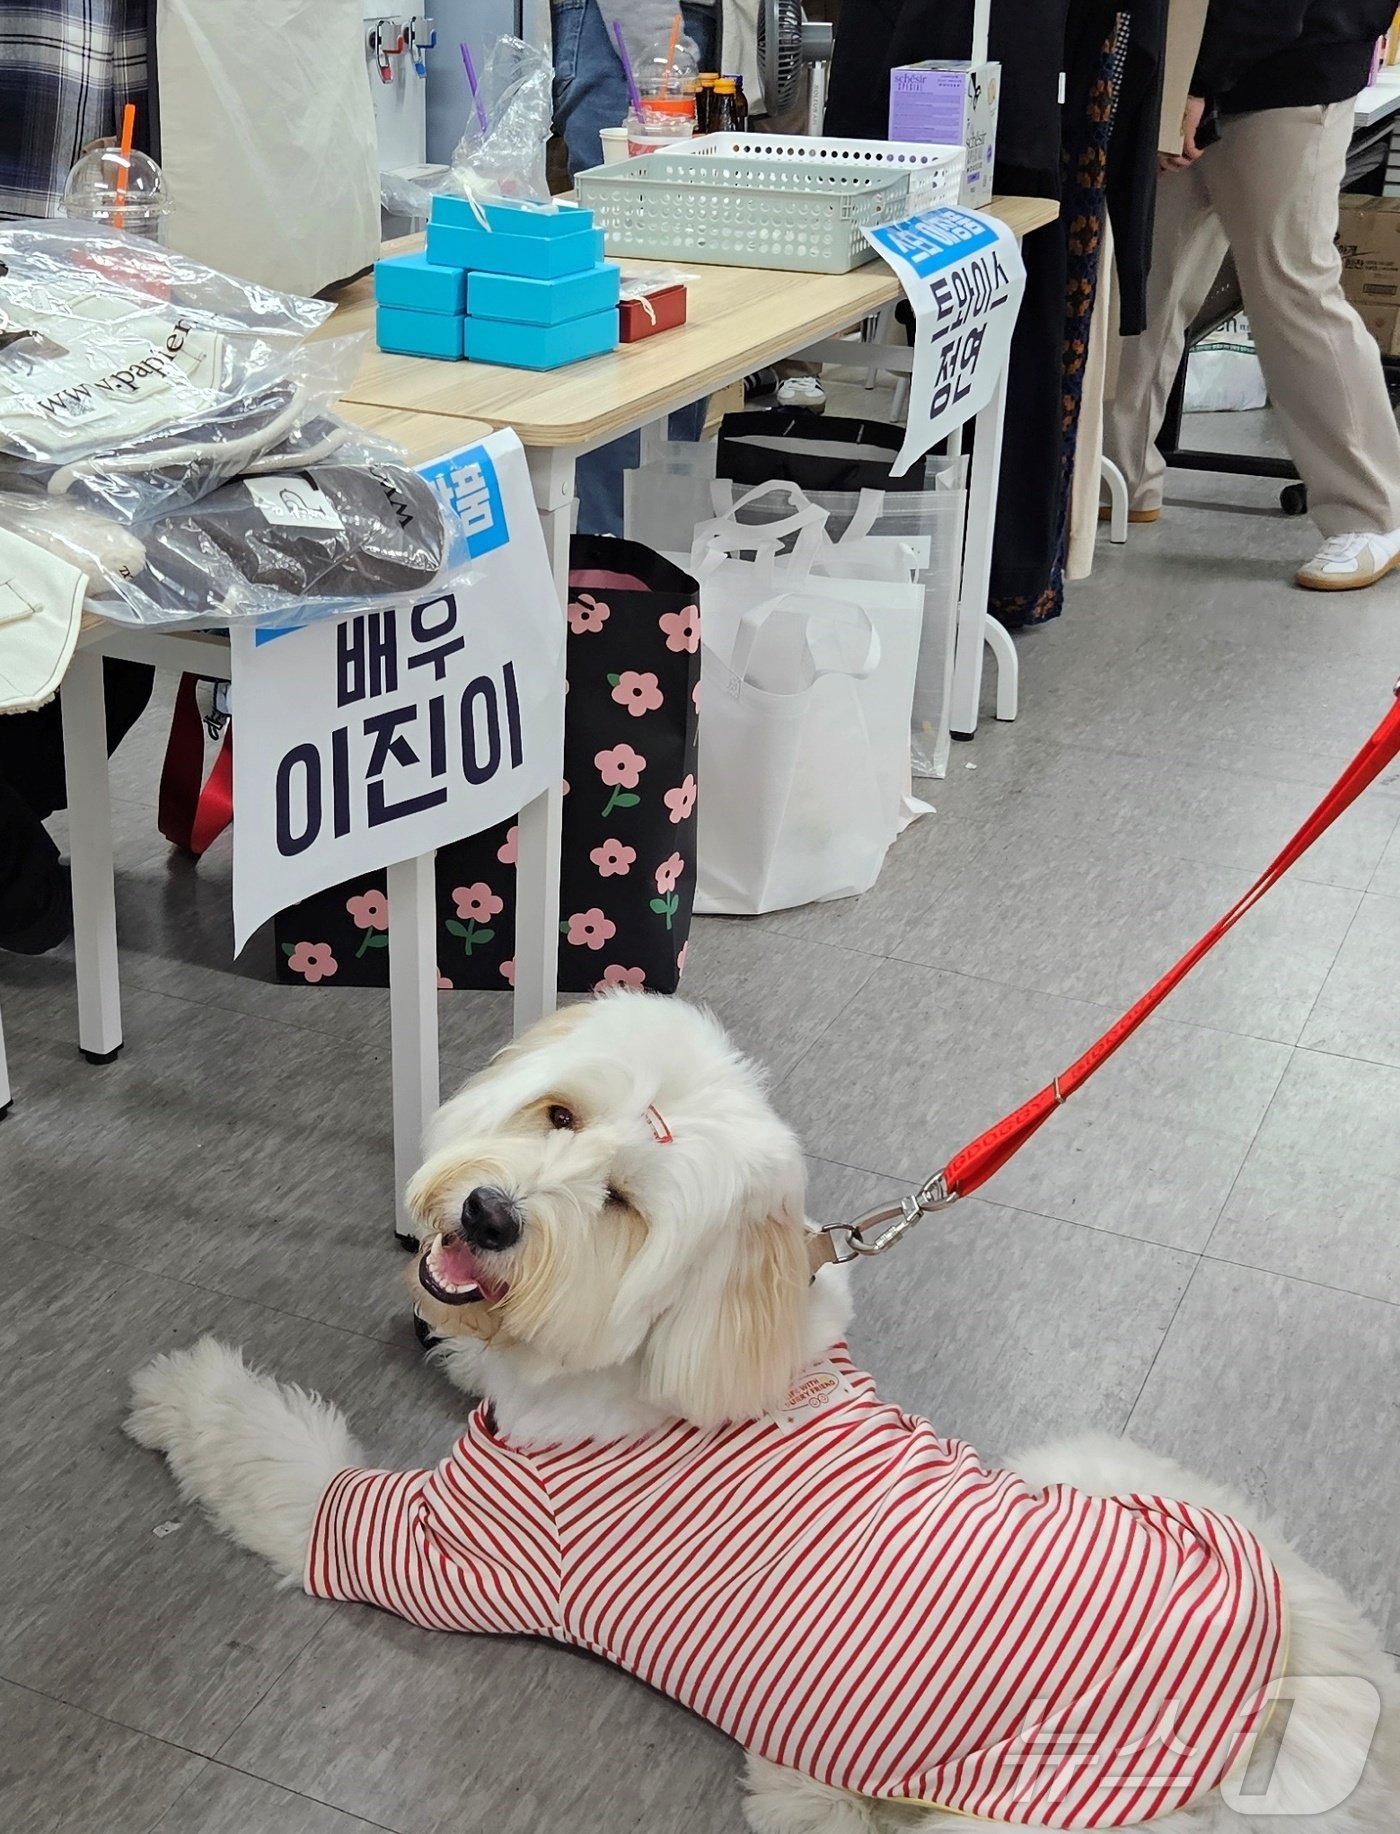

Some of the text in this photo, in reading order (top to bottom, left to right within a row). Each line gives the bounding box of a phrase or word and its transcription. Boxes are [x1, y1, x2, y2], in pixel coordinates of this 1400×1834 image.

[929, 250, 1010, 344] 트와이스
[929, 322, 988, 420] 정연
[336, 592, 466, 709] 배우
[275, 660, 524, 858] 이진이
[800, 1378, 820, 1391] WITH
